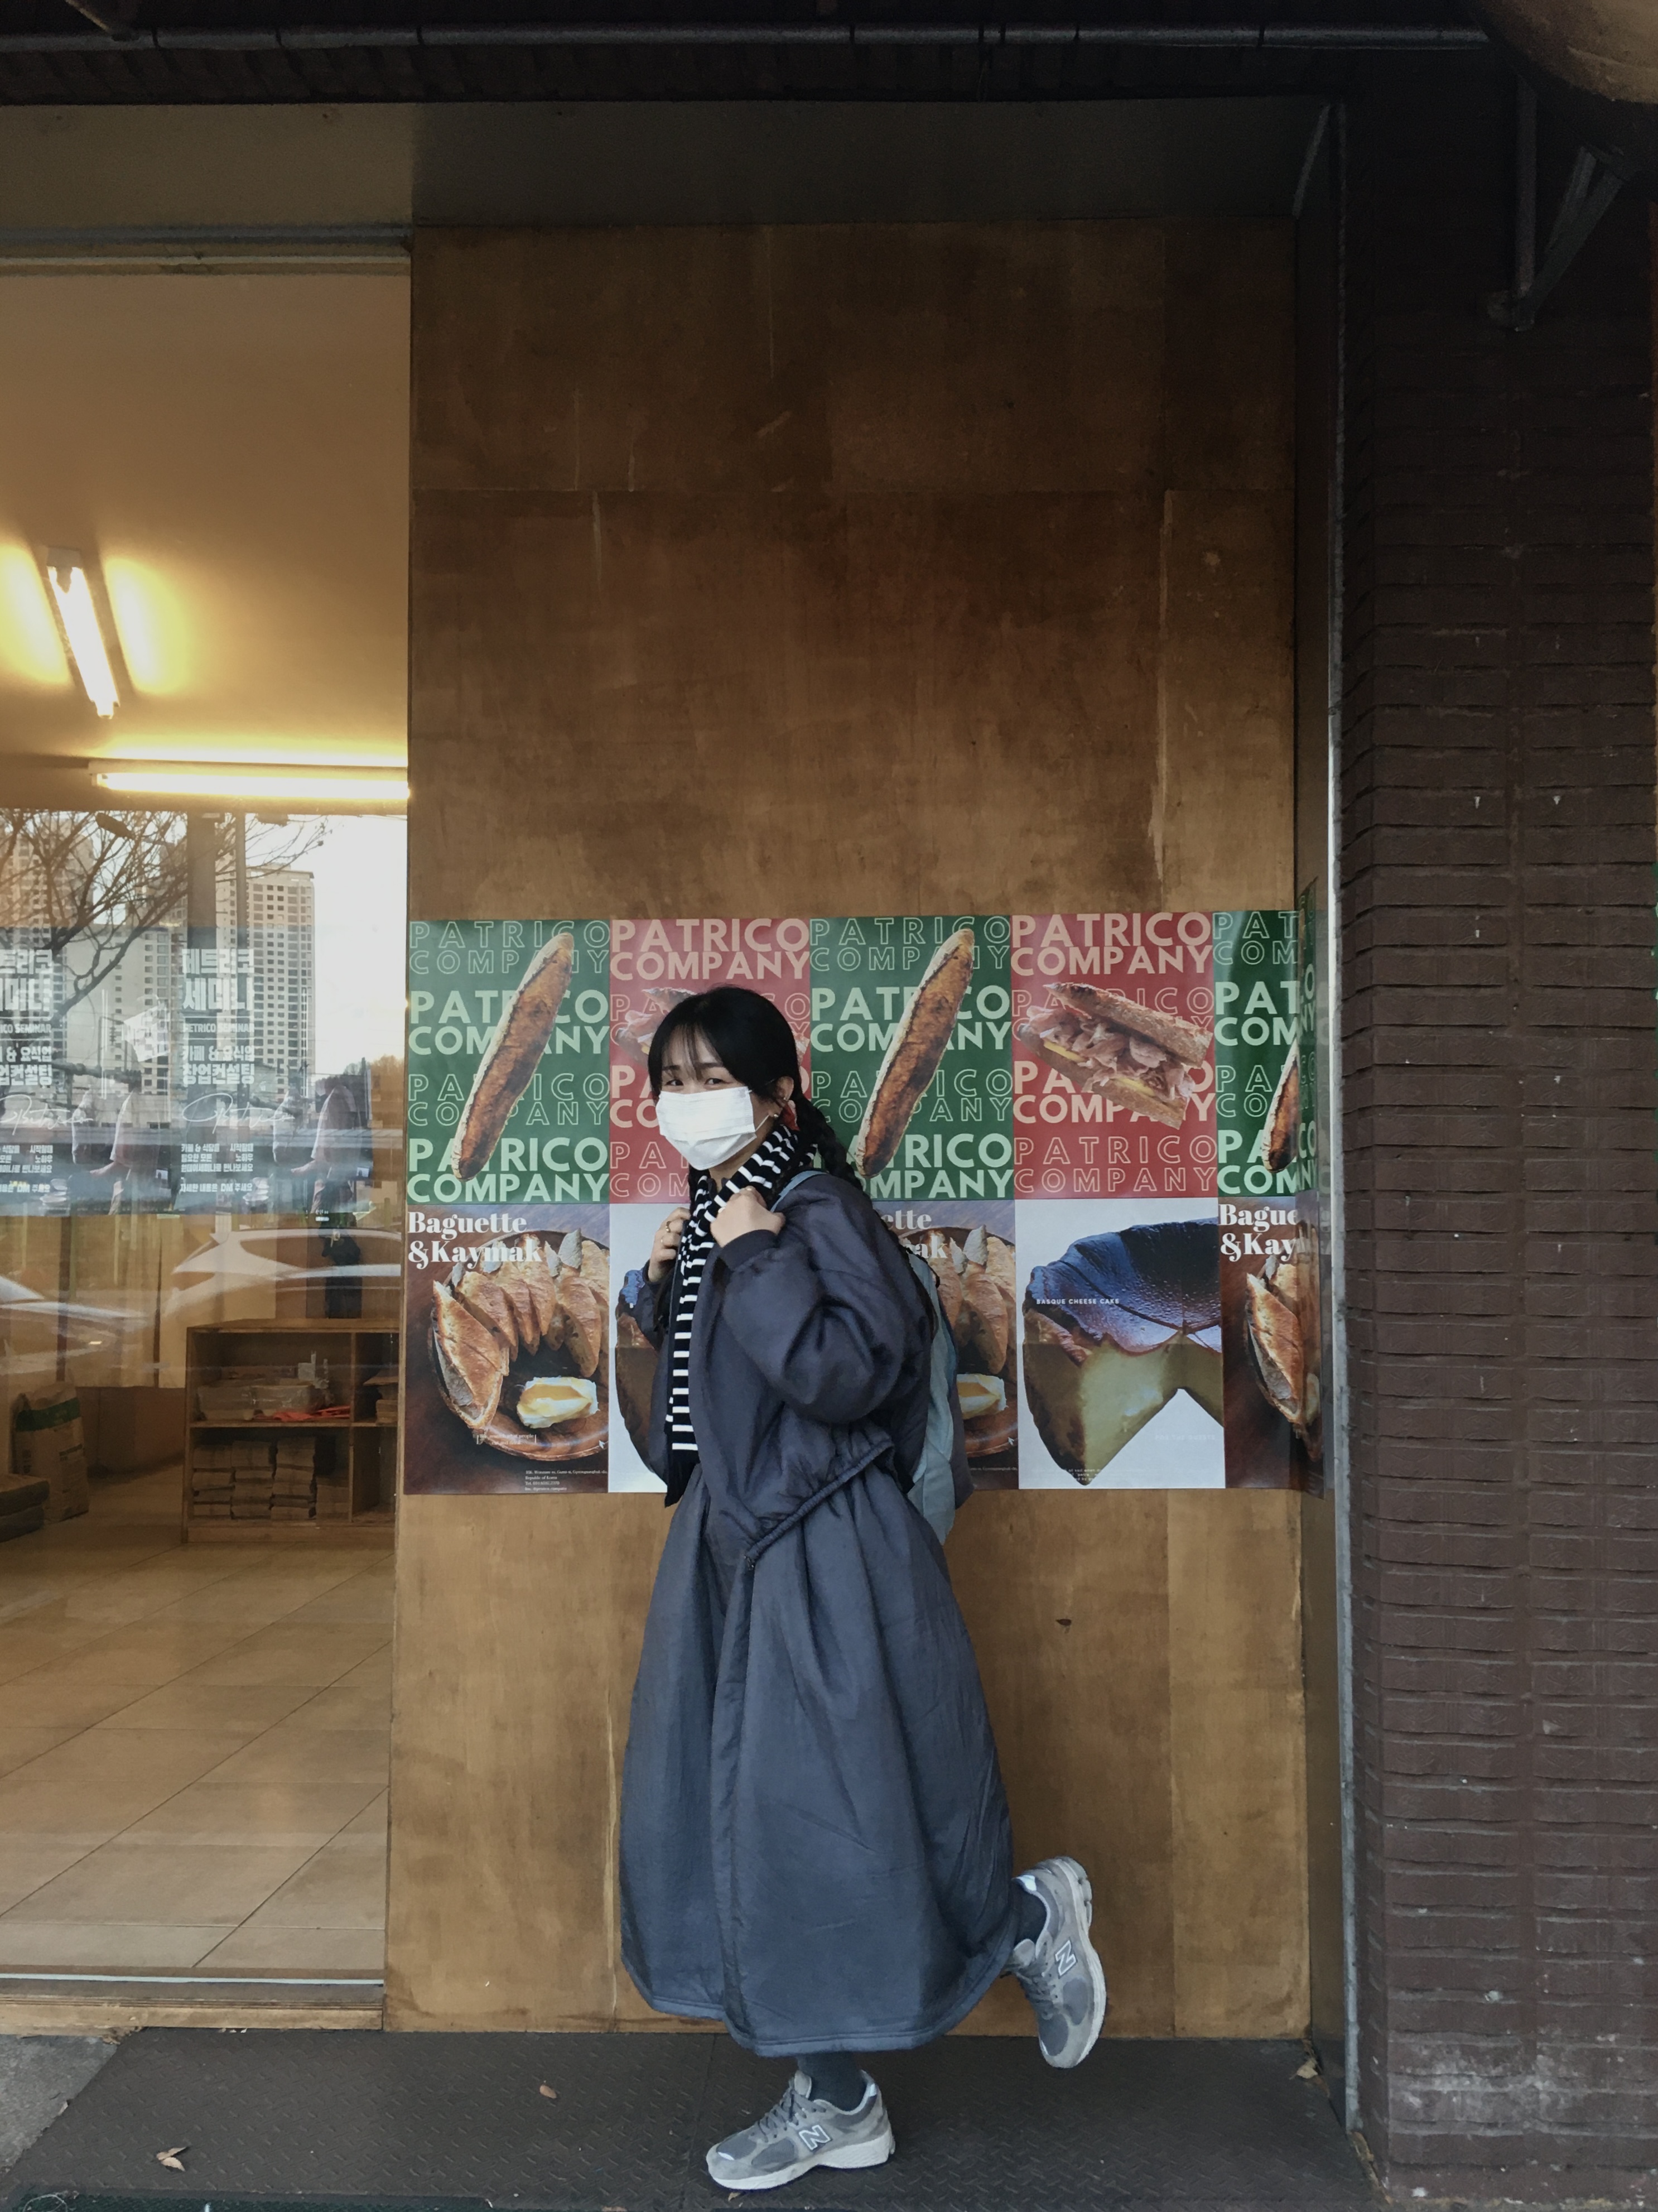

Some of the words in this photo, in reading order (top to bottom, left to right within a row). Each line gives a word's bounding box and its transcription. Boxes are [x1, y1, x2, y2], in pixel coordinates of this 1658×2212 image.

[611, 919, 809, 952] PATRICO
[1012, 912, 1211, 948] PATRICO
[410, 950, 609, 974] COMPY
[610, 951, 809, 980] COMPANY
[810, 946, 1010, 972] COMPY
[1010, 945, 1213, 976] COMPANY
[183, 978, 255, 1011] 세미나
[15, 1023, 51, 1033] SEMINAR
[218, 1023, 255, 1033] SEMINAR
[21, 1046, 52, 1062] 요식업
[182, 1063, 255, 1085] 창업컨설팅
[1014, 1135, 1217, 1165] PATRICO
[407, 1174, 609, 1203] COMPANY
[1014, 1167, 1217, 1193] COMPANY
[408, 1211, 527, 1240] Baguette
[408, 1238, 542, 1270] &Kaymak
[799, 2124, 831, 2151] N
